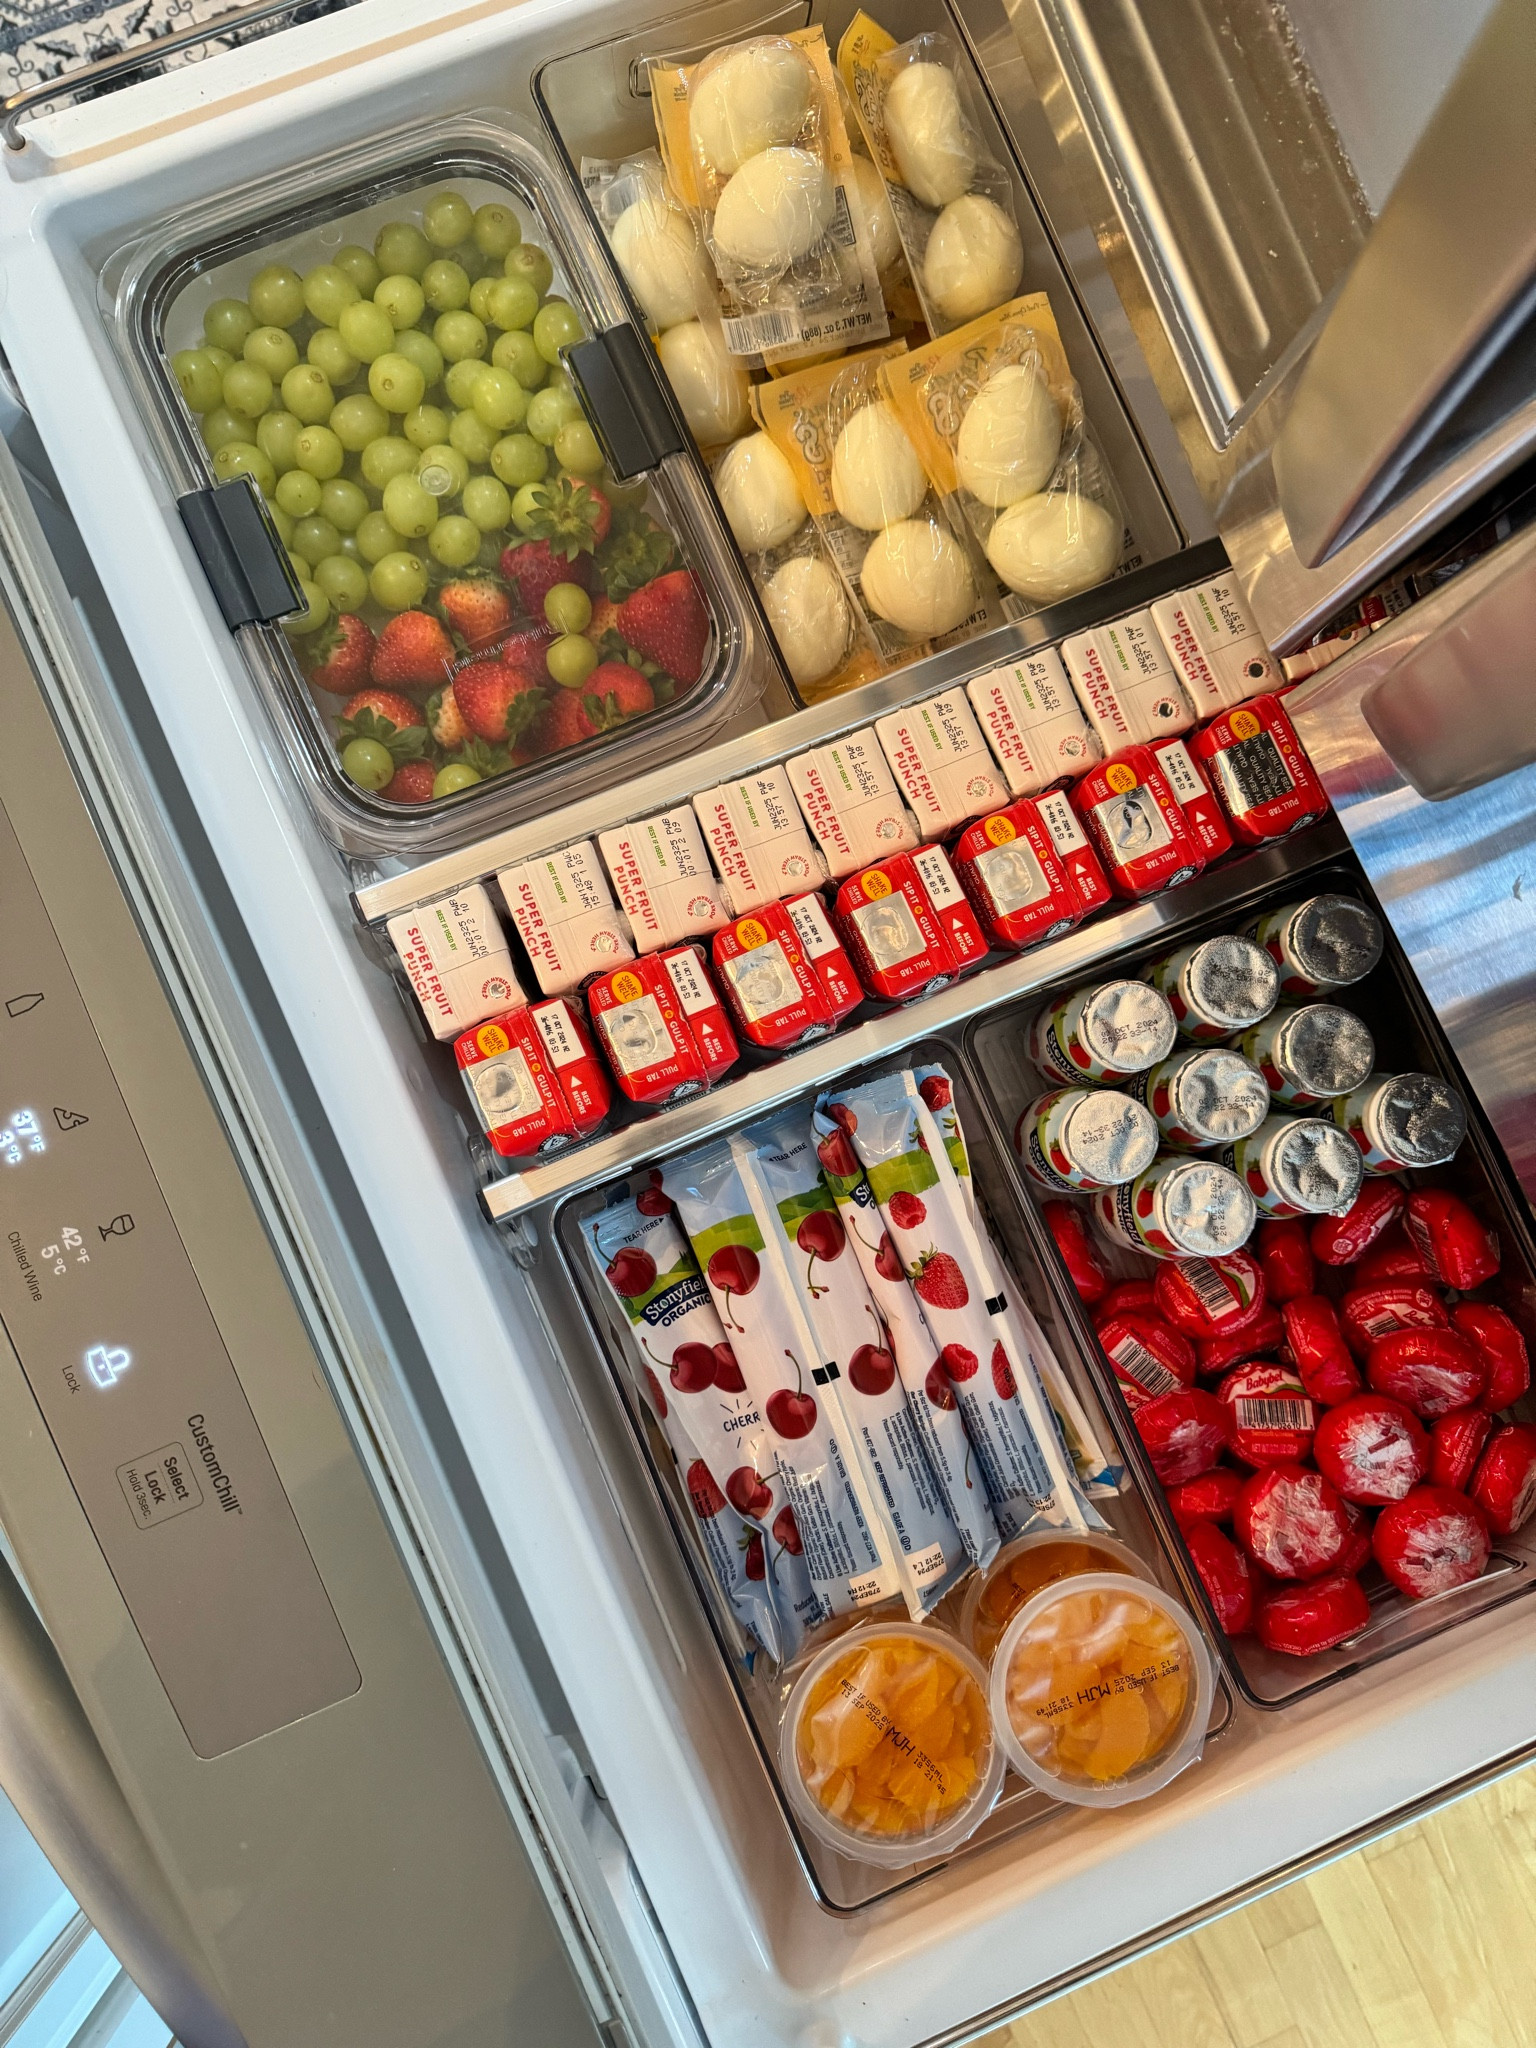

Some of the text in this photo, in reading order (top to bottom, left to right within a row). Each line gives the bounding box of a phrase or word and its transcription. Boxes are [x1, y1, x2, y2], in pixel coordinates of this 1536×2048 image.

[1169, 632, 1199, 681] PUNCH
[1172, 610, 1218, 696] SUPER FRUIT
[1081, 670, 1109, 720] PUNCH
[1084, 647, 1127, 735] SUPER FRUIT
[986, 710, 1014, 759] PUNCH
[989, 686, 1033, 774] SUPER FRUIT
[893, 750, 921, 799] PUNCH
[896, 727, 940, 814] SUPER FRUIT
[1271, 719, 1308, 788] SIP IT GULP IT
[802, 791, 830, 841] PUNCH
[806, 768, 850, 856] SUPER FRUIT
[1147, 773, 1185, 841] SIP IT GULP IT
[1267, 797, 1299, 817] PULL TAB
[709, 826, 736, 877] PUNCH
[713, 803, 755, 892] SUPER FRUIT
[1197, 824, 1213, 848] BEFORE
[1205, 824, 1217, 840] BEST
[612, 865, 639, 915] PUNCH
[617, 841, 658, 932] SUPER FRUIT
[514, 907, 541, 957] PUNCH
[518, 882, 561, 973] SUPER FRUIT
[902, 880, 939, 949] SIP IT GULP IT
[402, 951, 431, 1002] PUNCH
[407, 926, 452, 1017] SUPER FRUIT
[486, 1026, 506, 1052] SHAKE
[653, 983, 688, 1054] SIP IT GULP IT
[1114, 1017, 1157, 1034] OCT 2024
[460, 1041, 472, 1061] CHILLED
[465, 1040, 477, 1058] SERVE
[481, 1033, 497, 1054] WELL
[520, 1036, 556, 1108] SIP IT GULP IT
[512, 1117, 546, 1137] PULL TAB
[1081, 1126, 1125, 1147] OCT 2024
[773, 1143, 807, 1162] TEAR HERE
[1209, 1176, 1218, 1198] 2024
[623, 1219, 659, 1244] TEAR HERE
[8, 1231, 42, 1302] Chilled Wine
[61, 1365, 81, 1395] Lock
[1246, 1371, 1283, 1391] Babybel
[723, 1411, 761, 1432] CHERR
[144, 1470, 167, 1505] Lock
[162, 1455, 190, 1501] Select
[873, 1460, 883, 1474] KEEP
[125, 1468, 154, 1521] Hold 3sec.
[1113, 1659, 1171, 1685] 13 SEP 2025
[1149, 1672, 1158, 1680] IF
[1161, 1664, 1180, 1675] BEST
[840, 1678, 857, 1694] BEST
[856, 1692, 866, 1702] IF
[863, 1699, 882, 1716] USED
[850, 1697, 865, 1711] SEP
[1075, 1682, 1111, 1704] MJH
[883, 1725, 918, 1757] MJH
